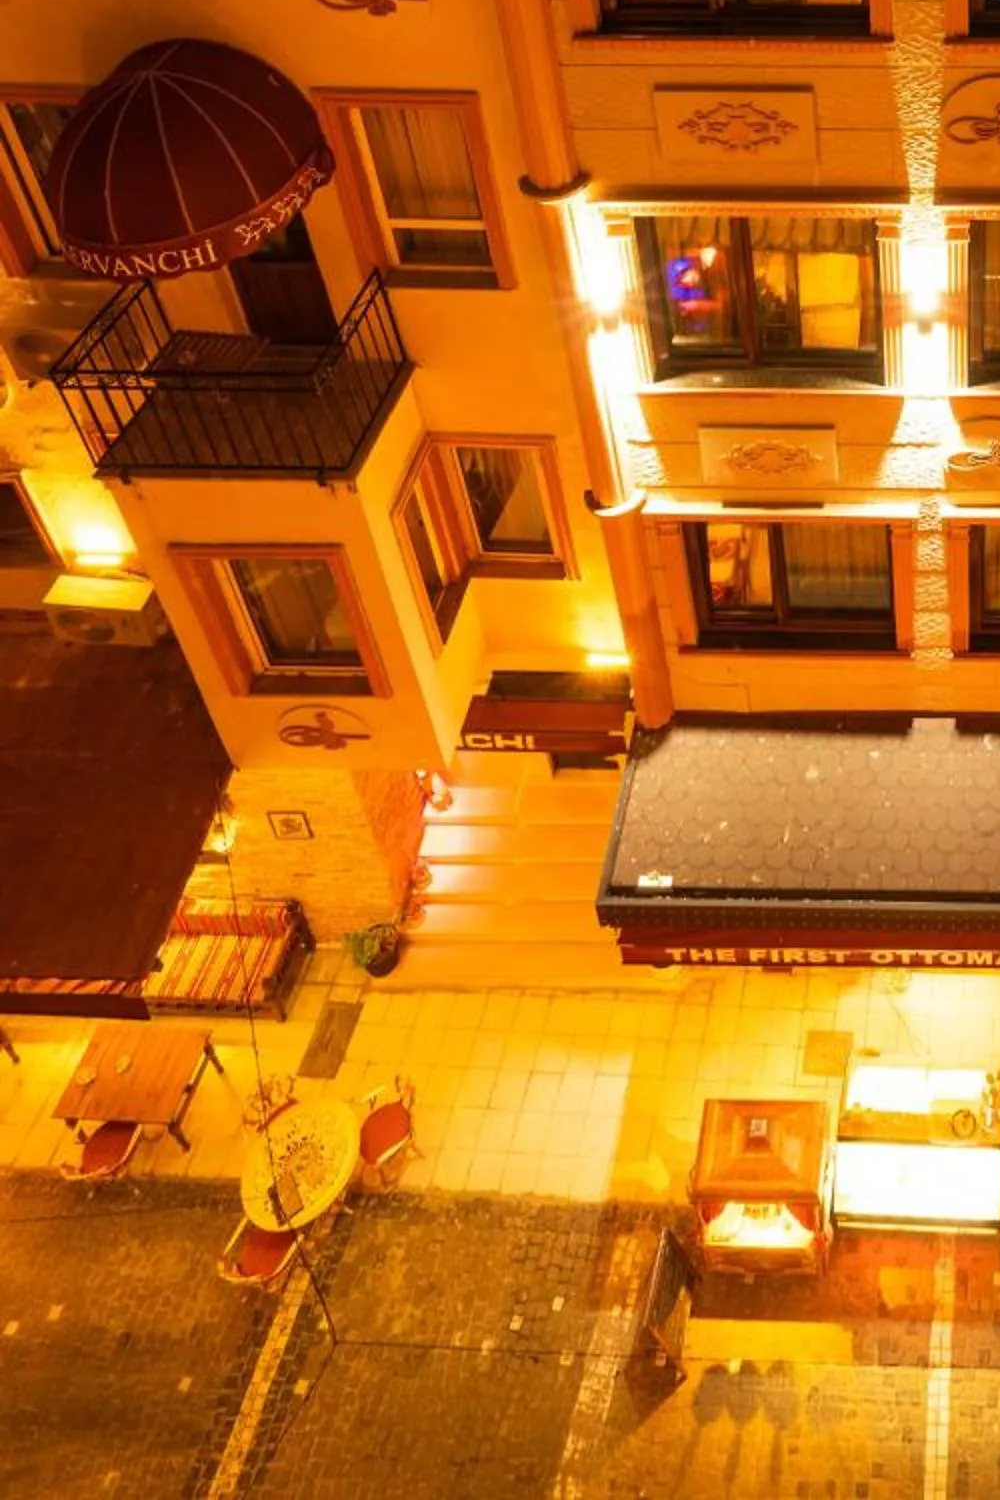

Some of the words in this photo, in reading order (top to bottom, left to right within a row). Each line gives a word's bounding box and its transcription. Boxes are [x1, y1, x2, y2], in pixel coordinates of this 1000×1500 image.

[460, 733, 535, 749] CHI
[666, 948, 737, 963] THE
[749, 948, 851, 964] FIRST
